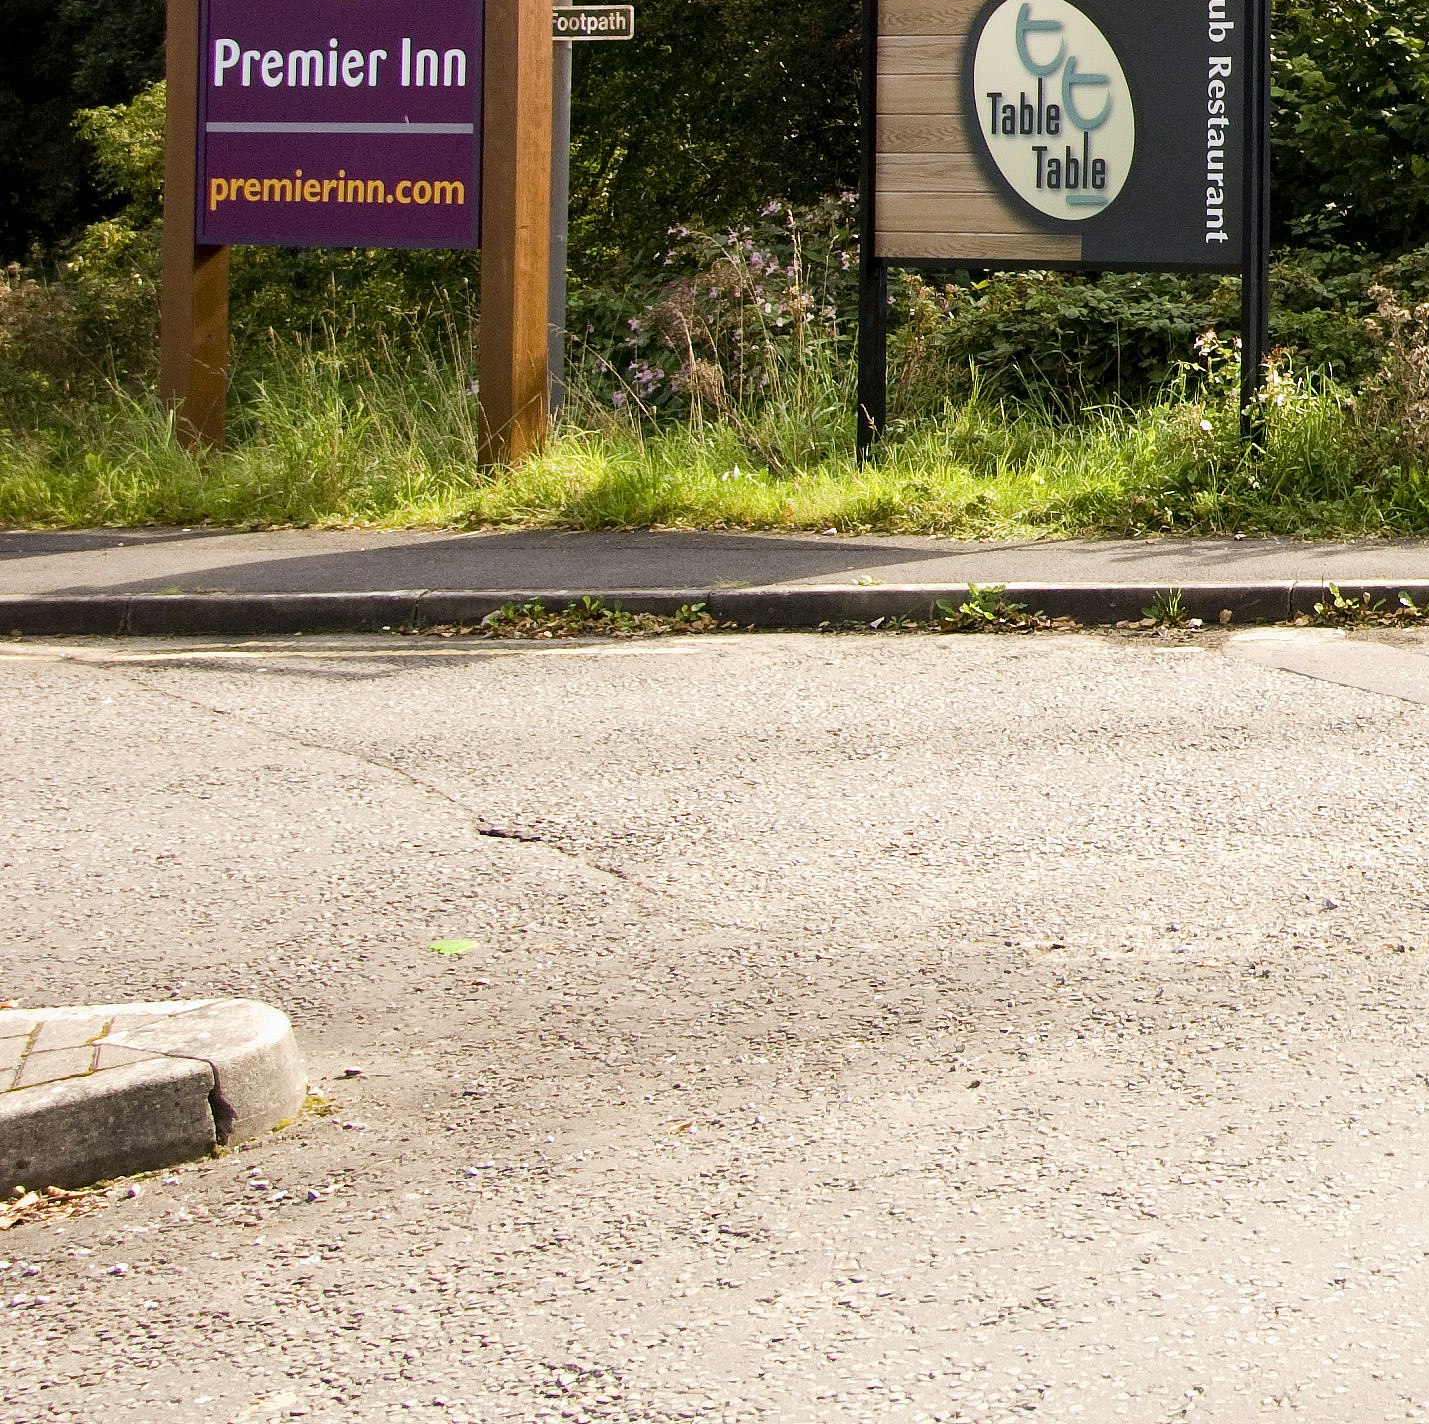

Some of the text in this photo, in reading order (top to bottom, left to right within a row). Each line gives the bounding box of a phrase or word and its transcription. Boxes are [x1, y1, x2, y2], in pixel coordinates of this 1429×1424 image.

[214, 38, 467, 87] Premier Inn
[986, 78, 1060, 135] Table
[1032, 132, 1106, 189] Table
[1206, 56, 1232, 243] Restaurant
[209, 169, 465, 211] premierinn.com
